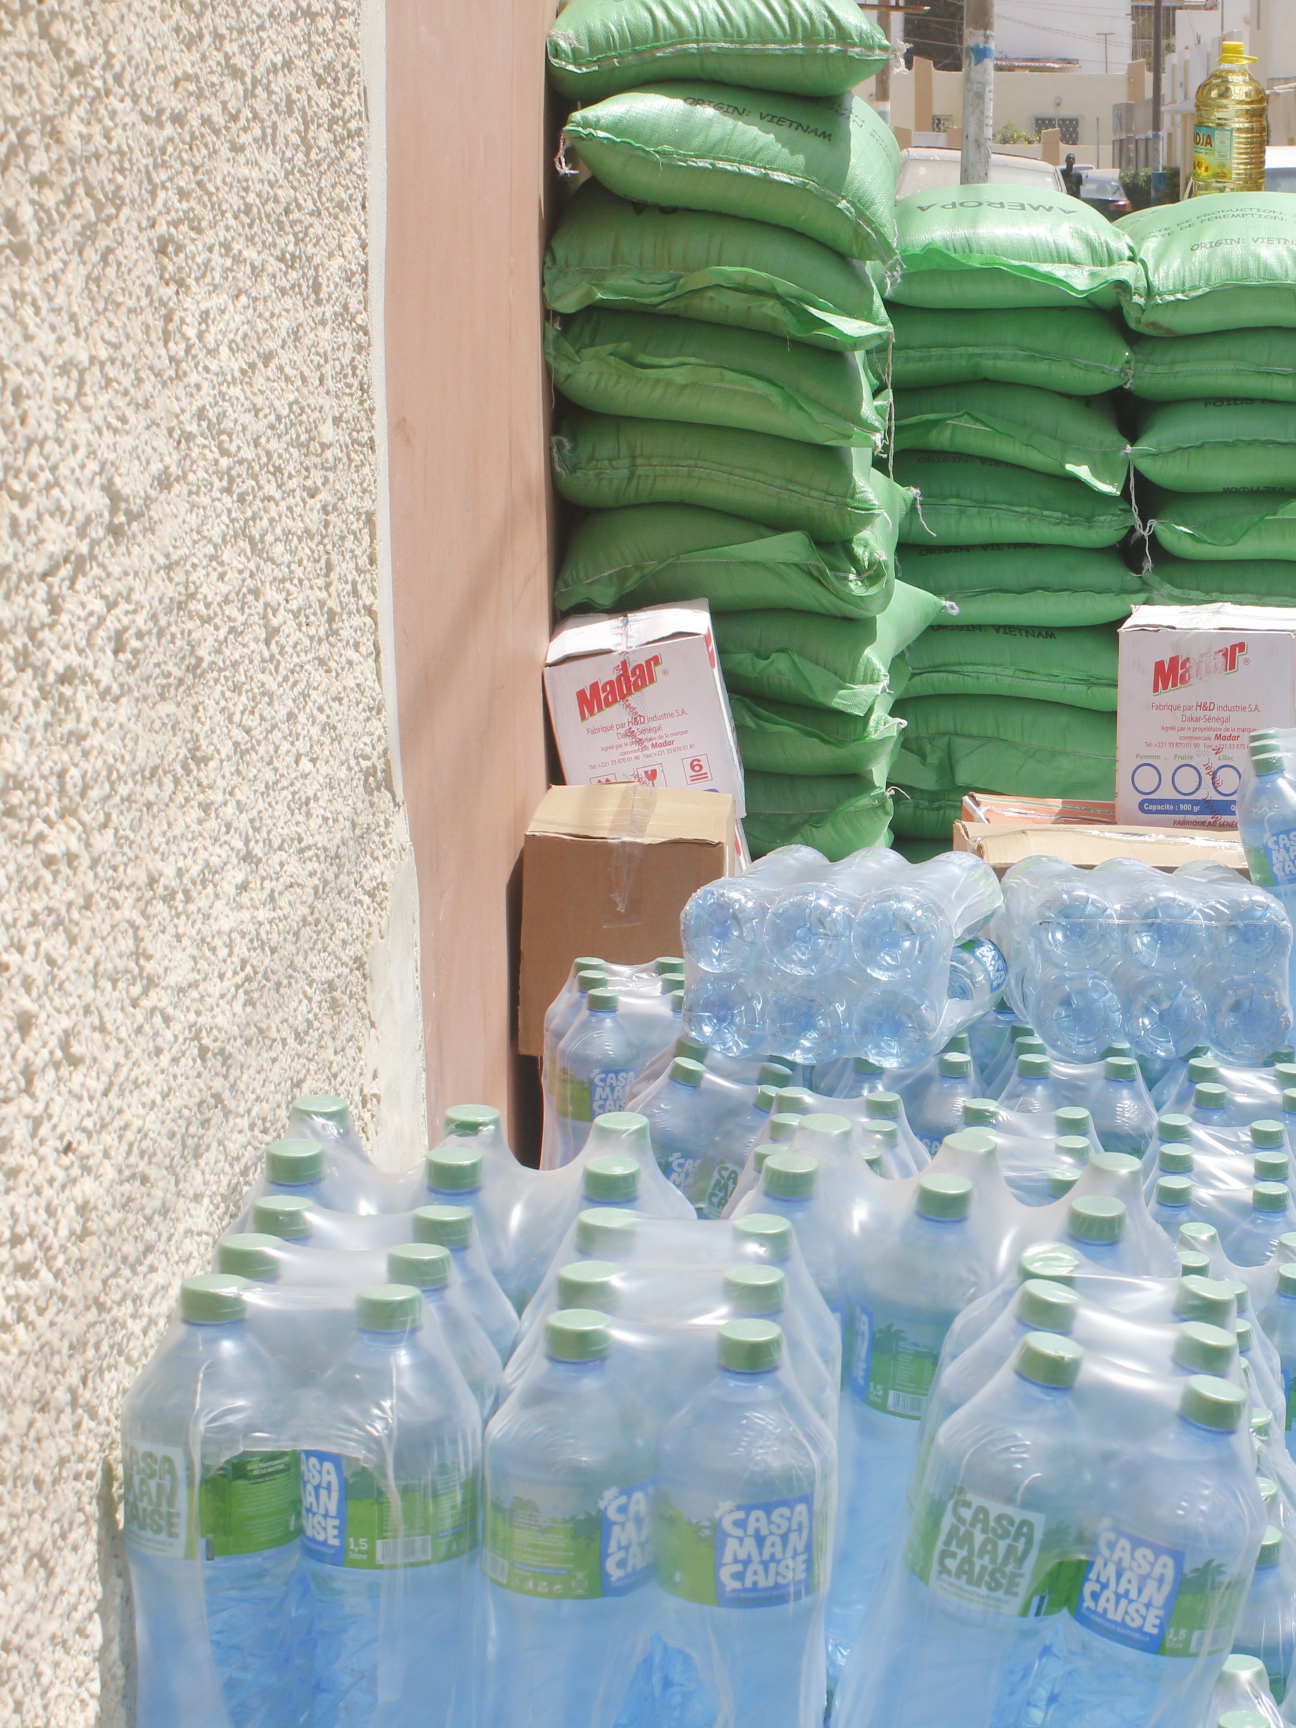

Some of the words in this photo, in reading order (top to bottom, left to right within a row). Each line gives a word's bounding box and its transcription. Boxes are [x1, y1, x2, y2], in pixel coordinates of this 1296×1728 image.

[684, 96, 750, 117] ORIGIN:
[759, 112, 832, 142] VIETNAM
[916, 200, 1078, 216] AMEROPA
[1190, 238, 1244, 252] ORIGIN:
[992, 625, 1057, 640] VIETNAM
[1153, 641, 1247, 696] Madar
[576, 653, 662, 722] Madar
[586, 723, 616, 736] Fabriqué
[616, 722, 626, 731] par
[628, 714, 646, 727] H&D
[646, 711, 676, 722] industrie
[676, 708, 688, 717] S.A.
[1151, 702, 1182, 713] Fabriqué
[1183, 704, 1194, 713] par
[1195, 702, 1216, 712] H&D
[1216, 704, 1248, 712] industrie
[1248, 704, 1261, 712] S.A.
[1181, 714, 1231, 725] Dakar-Sénégal
[650, 740, 675, 750] Madar
[1214, 734, 1240, 742] Madar
[690, 758, 704, 773] 6
[1144, 802, 1174, 812] Capacité
[1194, 804, 1200, 812] gr
[722, 1503, 809, 1538] CASA
[952, 1500, 1035, 1544] CASA
[348, 1538, 368, 1551] 1,5
[722, 1526, 809, 1564] MAN
[942, 1524, 1034, 1569] MAN
[1098, 1532, 1175, 1578] CASA
[719, 1553, 808, 1592] ÇAISE
[938, 1548, 1024, 1598] ÇAISE
[1088, 1555, 1172, 1608] MAN
[1082, 1582, 1165, 1635] ÇAISE
[1168, 1628, 1188, 1641] 1,5
